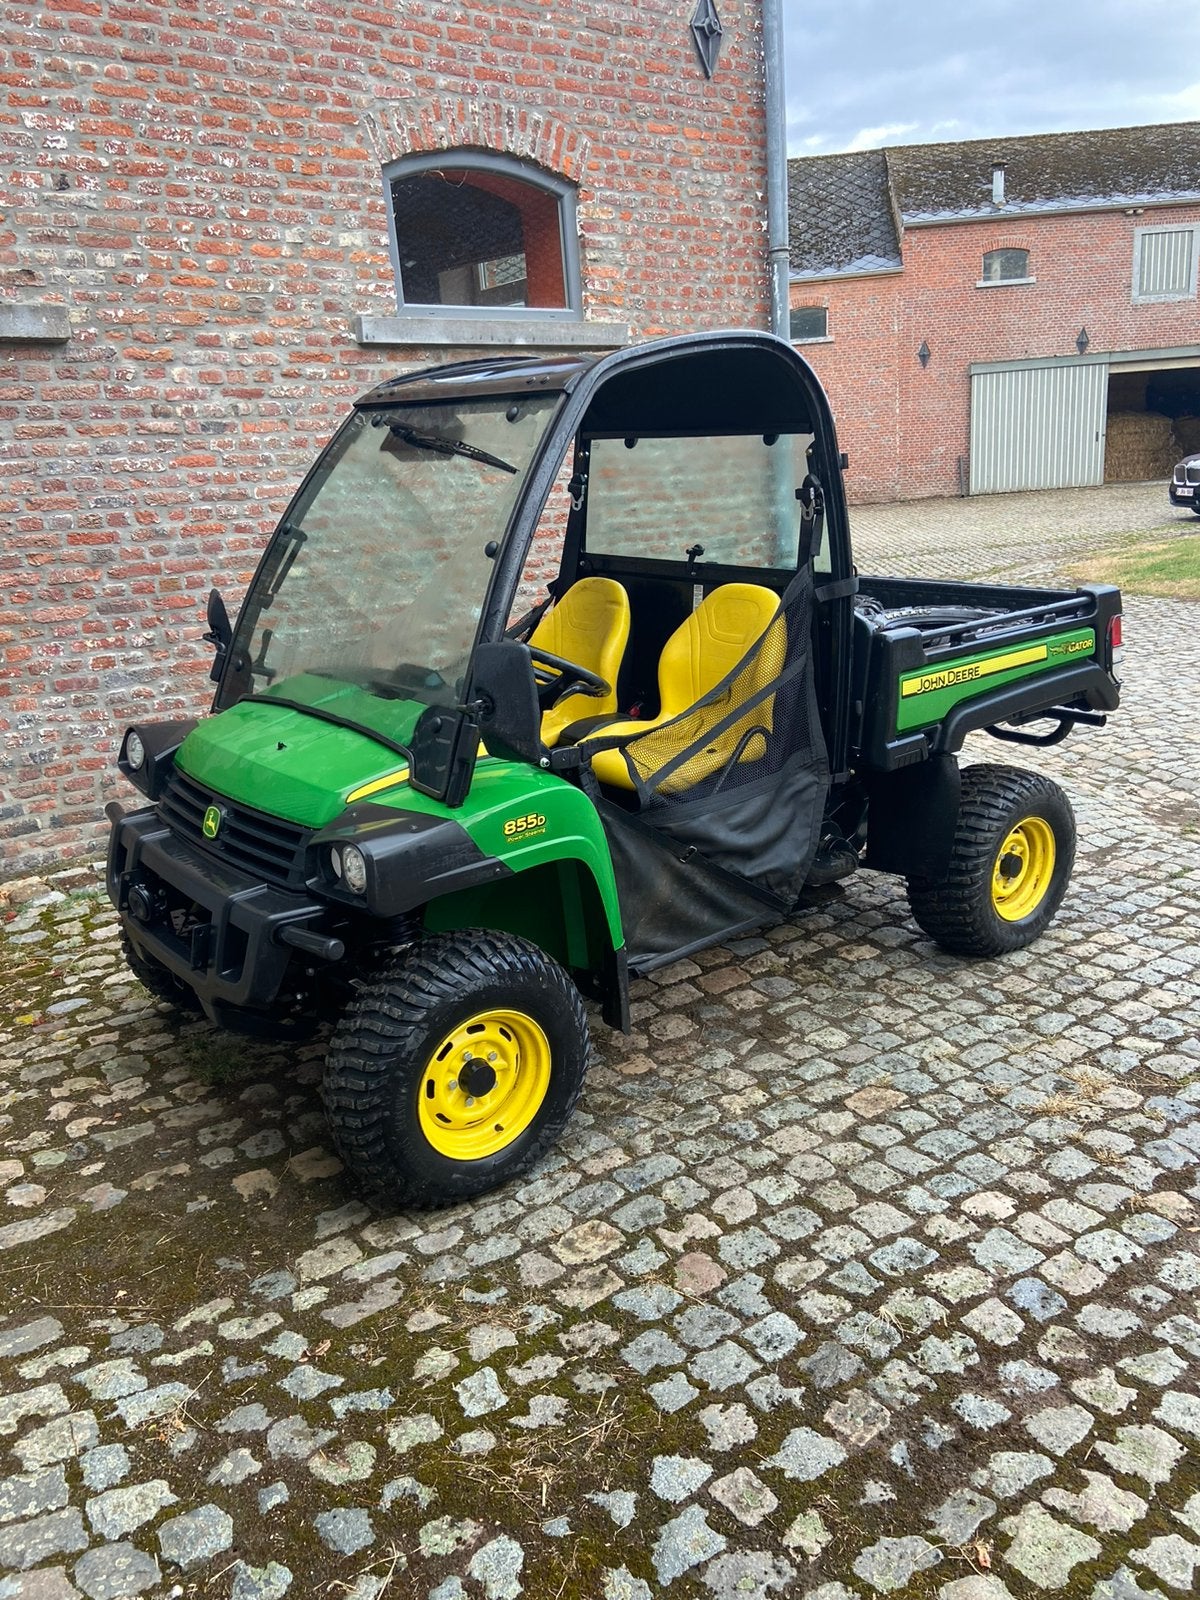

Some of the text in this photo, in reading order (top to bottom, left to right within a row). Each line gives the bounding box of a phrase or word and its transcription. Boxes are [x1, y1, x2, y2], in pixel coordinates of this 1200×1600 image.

[1068, 638, 1093, 653] GATOR
[916, 666, 980, 692] JOHN DEERE
[503, 812, 546, 836] 855D
